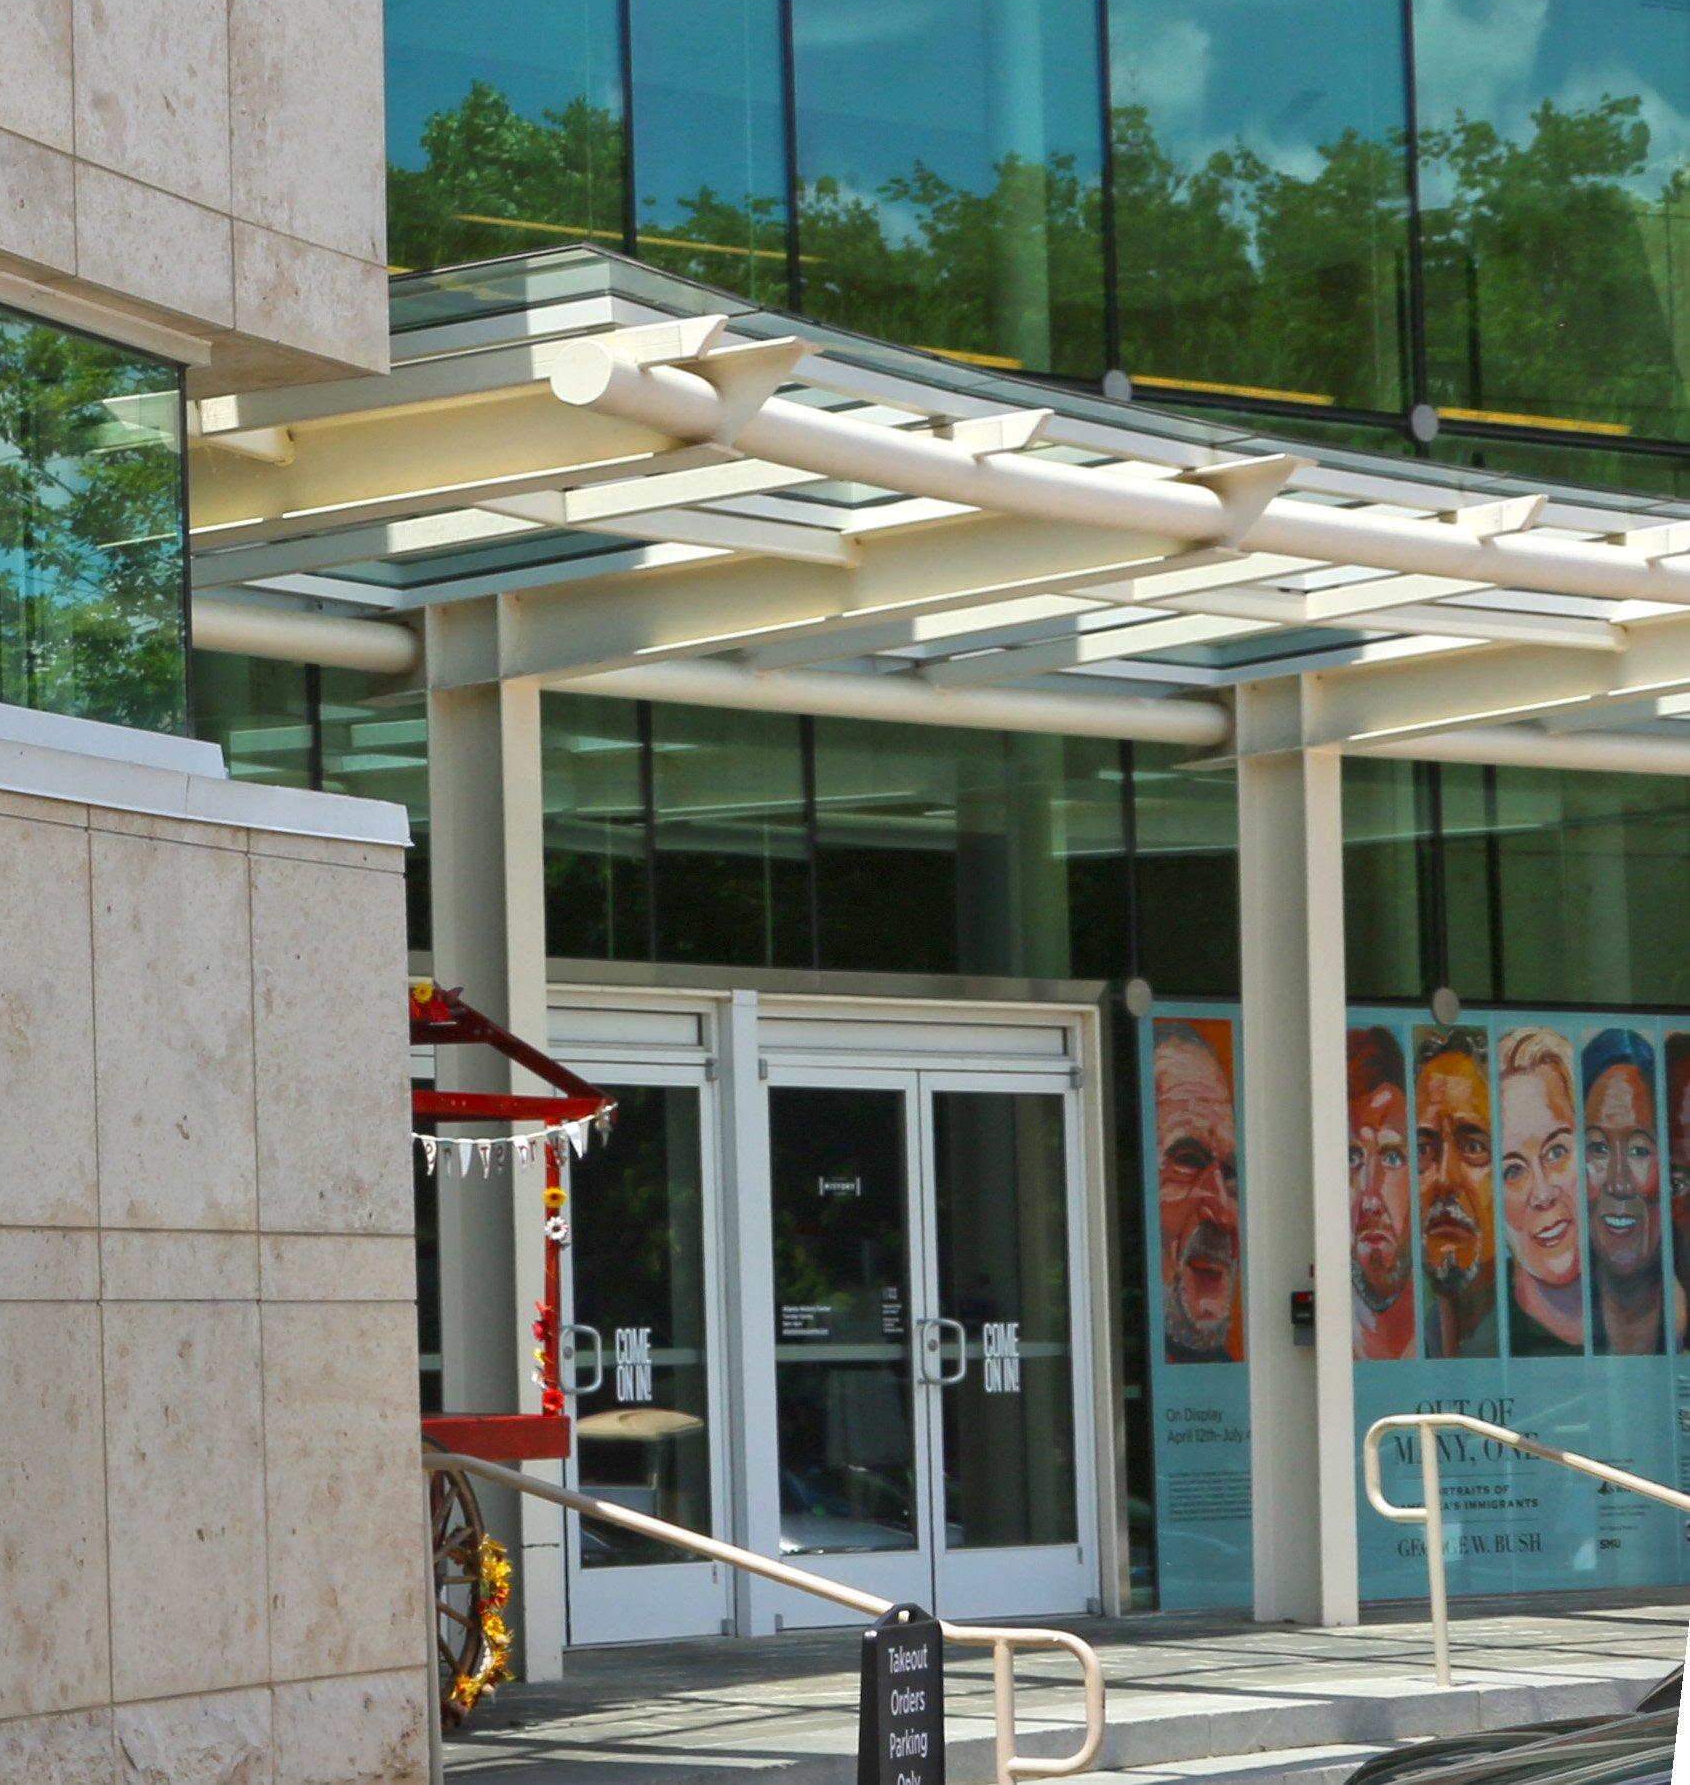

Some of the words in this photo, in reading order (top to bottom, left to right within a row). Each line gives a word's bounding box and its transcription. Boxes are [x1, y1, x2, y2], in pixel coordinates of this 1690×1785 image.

[616, 1328, 651, 1365] COME
[983, 1323, 1019, 1357] COME
[617, 1365, 634, 1402] ON
[636, 1364, 652, 1401] IN!
[985, 1357, 1002, 1392] ON
[1004, 1357, 1020, 1392] IN!
[1166, 1408, 1180, 1422] On
[1184, 1407, 1222, 1423] Display
[1477, 1398, 1515, 1427] OF
[1167, 1429, 1193, 1444] April
[1394, 1433, 1476, 1465] MNY,
[1464, 1498, 1539, 1510] IMMIGRANTS
[1494, 1484, 1510, 1495] OF
[1471, 1534, 1490, 1554] W.
[1495, 1532, 1542, 1553] BUSH
[1599, 1538, 1621, 1550] SMU
[888, 1644, 928, 1674] Takeout
[891, 1687, 925, 1716] Orders
[889, 1729, 928, 1759] Parking
